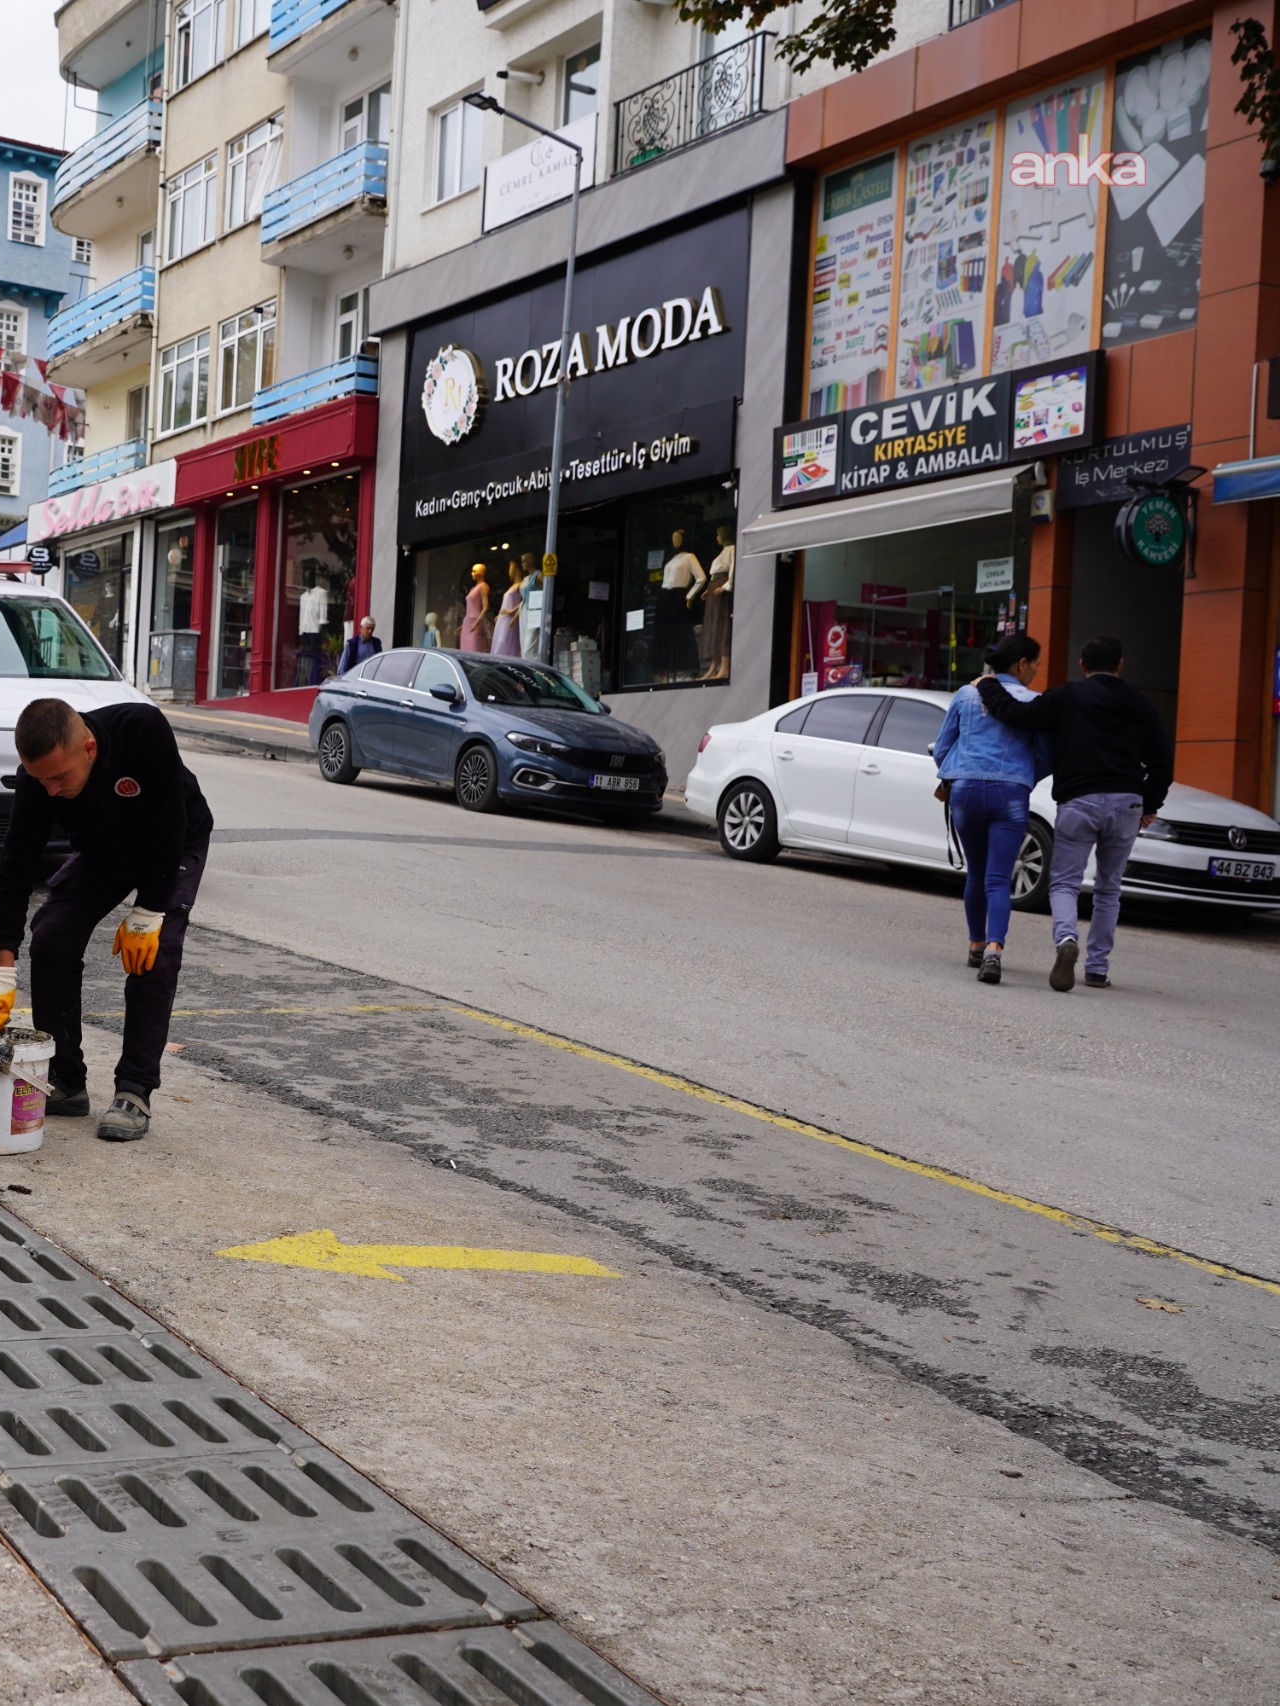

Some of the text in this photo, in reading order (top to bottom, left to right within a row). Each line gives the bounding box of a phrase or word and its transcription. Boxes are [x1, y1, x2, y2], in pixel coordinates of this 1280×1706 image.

[499, 171, 534, 197] CEMRE
[494, 286, 723, 402] ROZA MODA
[1061, 430, 1188, 466] KURTULMUŞ
[415, 497, 446, 518] Kadın
[451, 489, 480, 509] Genç
[486, 475, 522, 506] Çocuk
[570, 448, 624, 481] Tesettür
[632, 441, 647, 470] İç
[650, 432, 691, 464] Giyim
[841, 441, 1003, 491] KİTAP & AMBALAJ
[1075, 455, 1169, 487] İş Merkezi
[36, 483, 113, 539] Selda
[1141, 501, 1178, 519] YEMEN
[595, 775, 638, 789] 11 ABR 858
[1217, 861, 1274, 879] 44 BZ 843
